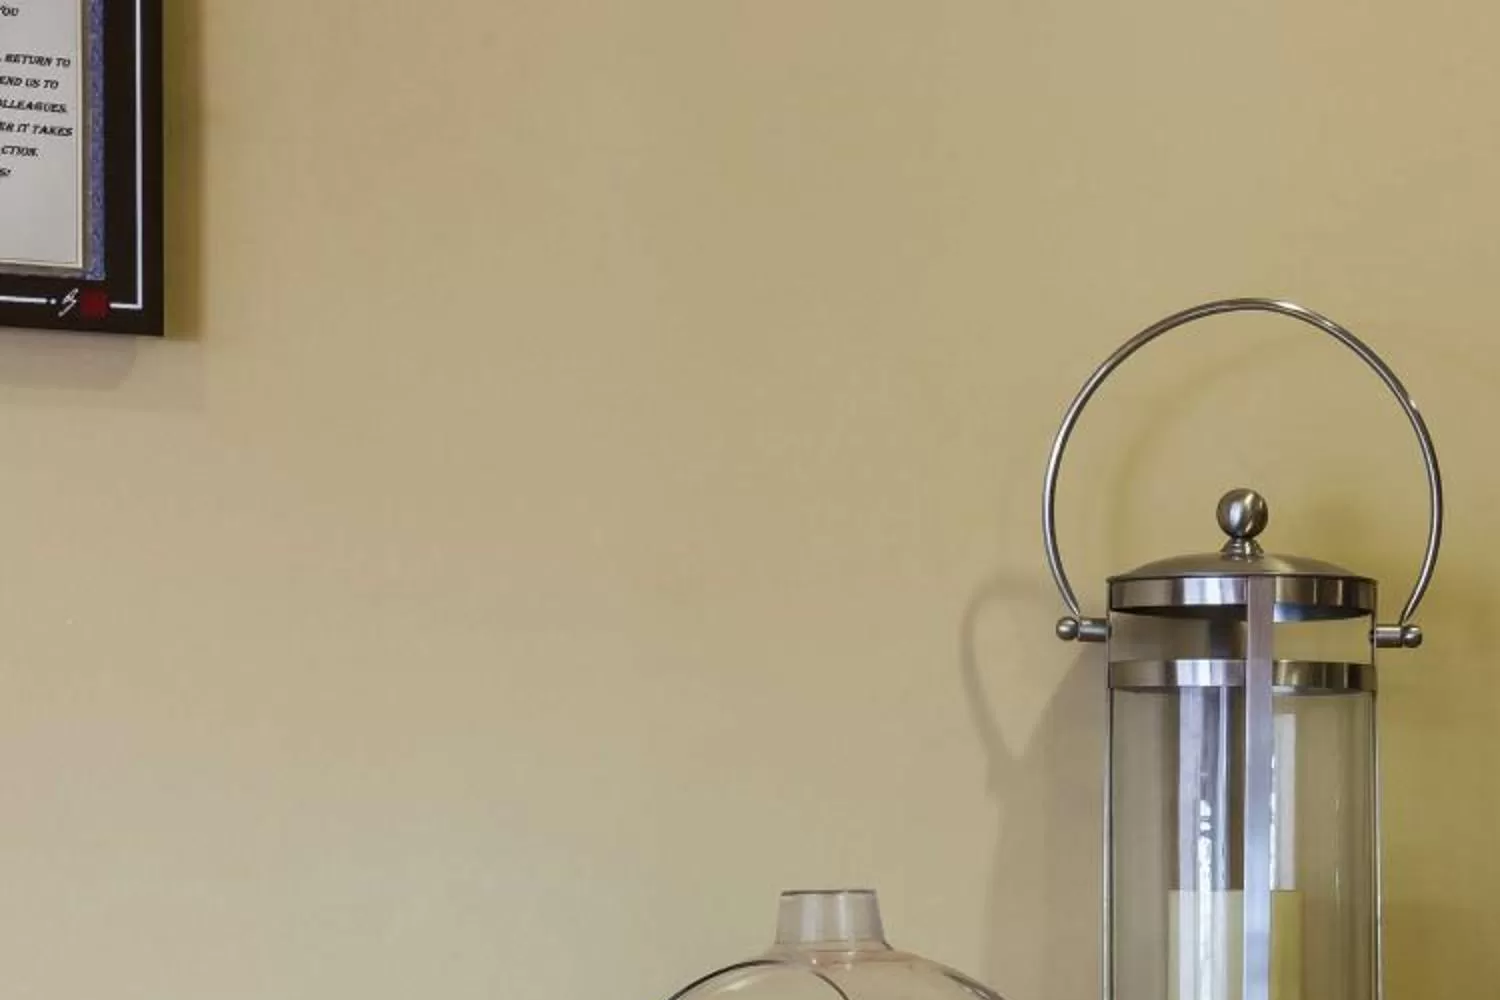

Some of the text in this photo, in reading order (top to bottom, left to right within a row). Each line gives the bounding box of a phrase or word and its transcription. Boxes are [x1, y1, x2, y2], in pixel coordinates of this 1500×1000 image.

[5, 53, 71, 68] RETURN TO
[25, 77, 41, 89] US
[43, 79, 59, 90] TO
[17, 123, 30, 133] IT
[32, 125, 74, 137] TAKES
